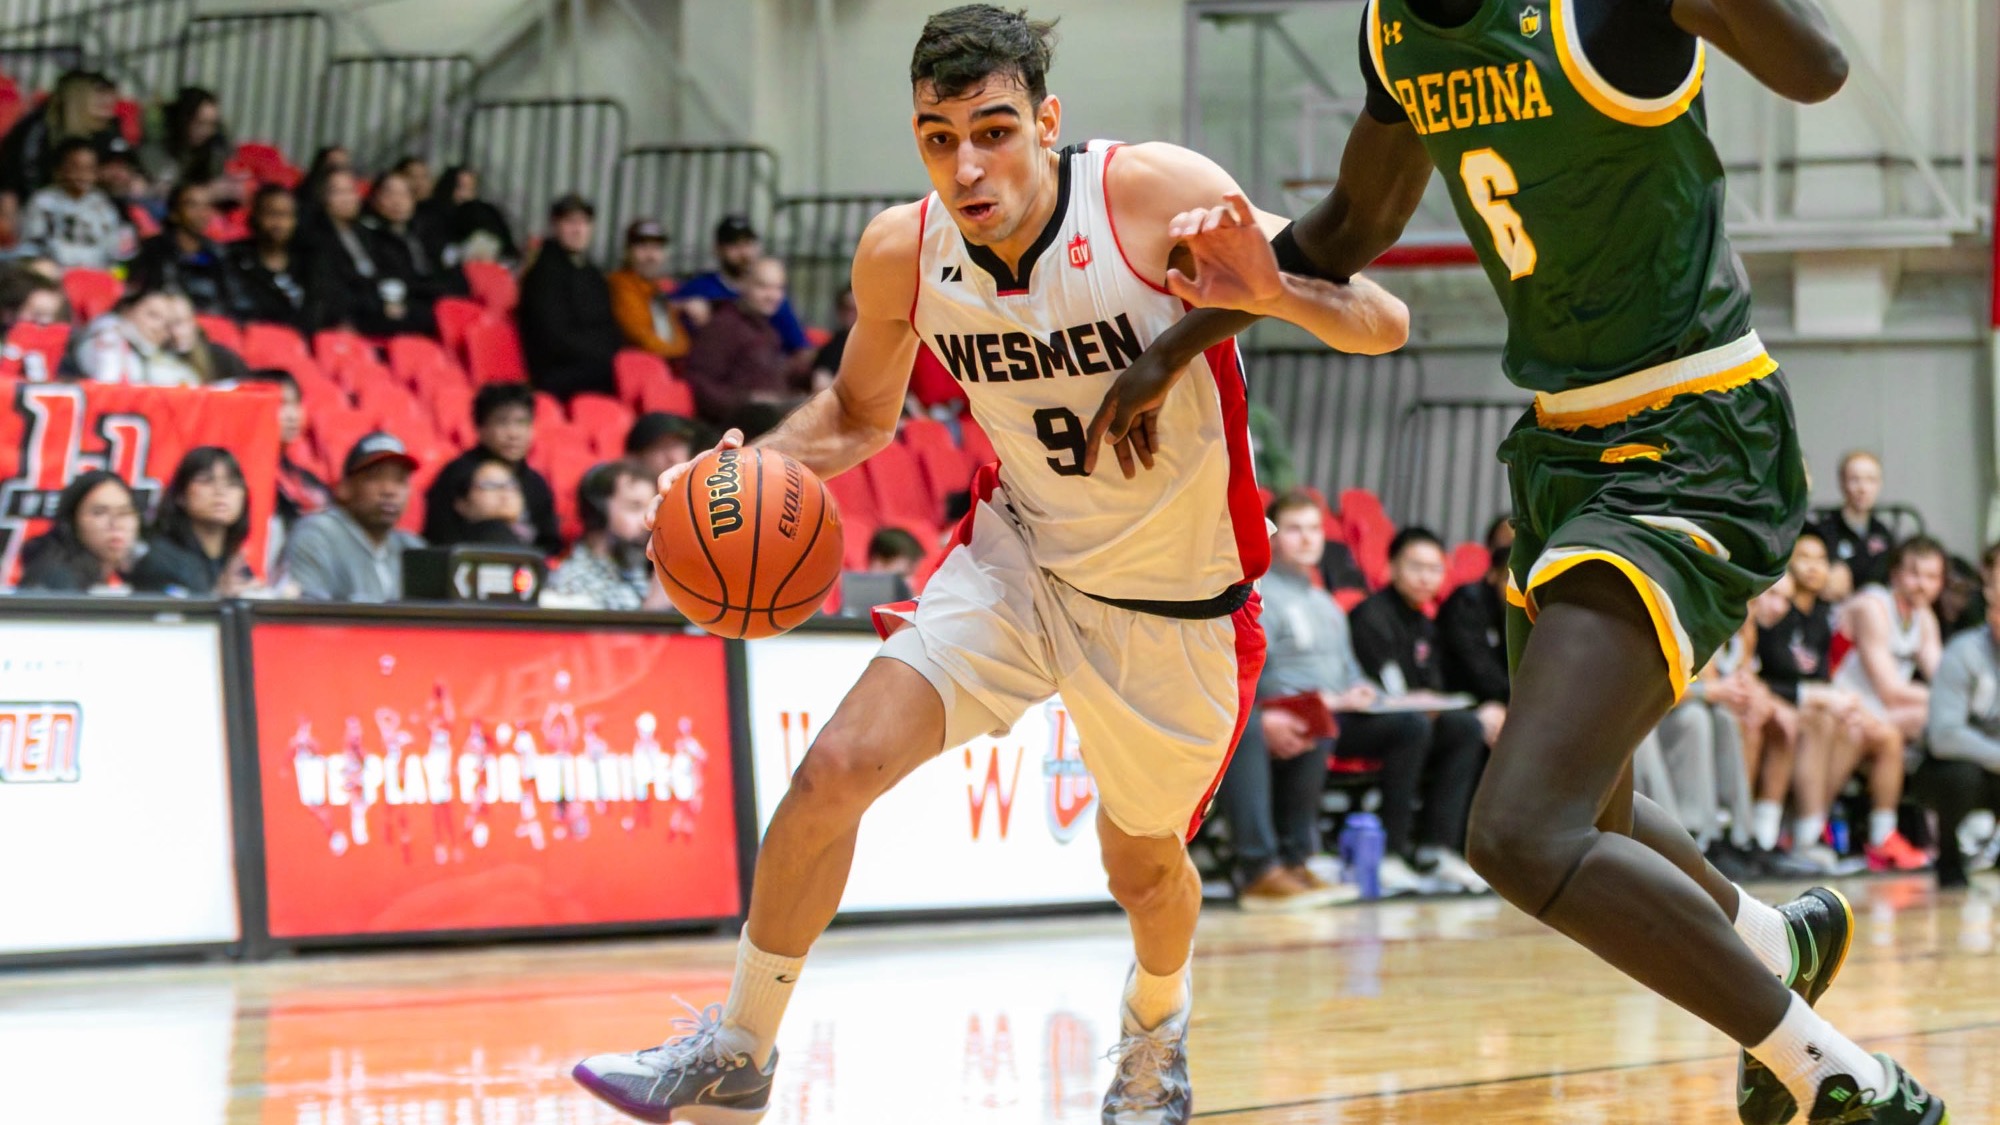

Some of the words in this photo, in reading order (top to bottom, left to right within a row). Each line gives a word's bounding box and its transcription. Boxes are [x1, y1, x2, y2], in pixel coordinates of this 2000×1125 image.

[1394, 59, 1553, 135] REGINA
[1460, 147, 1537, 281] 6
[934, 312, 1144, 383] WESMEN
[1032, 406, 1091, 477] 9
[778, 458, 801, 539] EVOLUT
